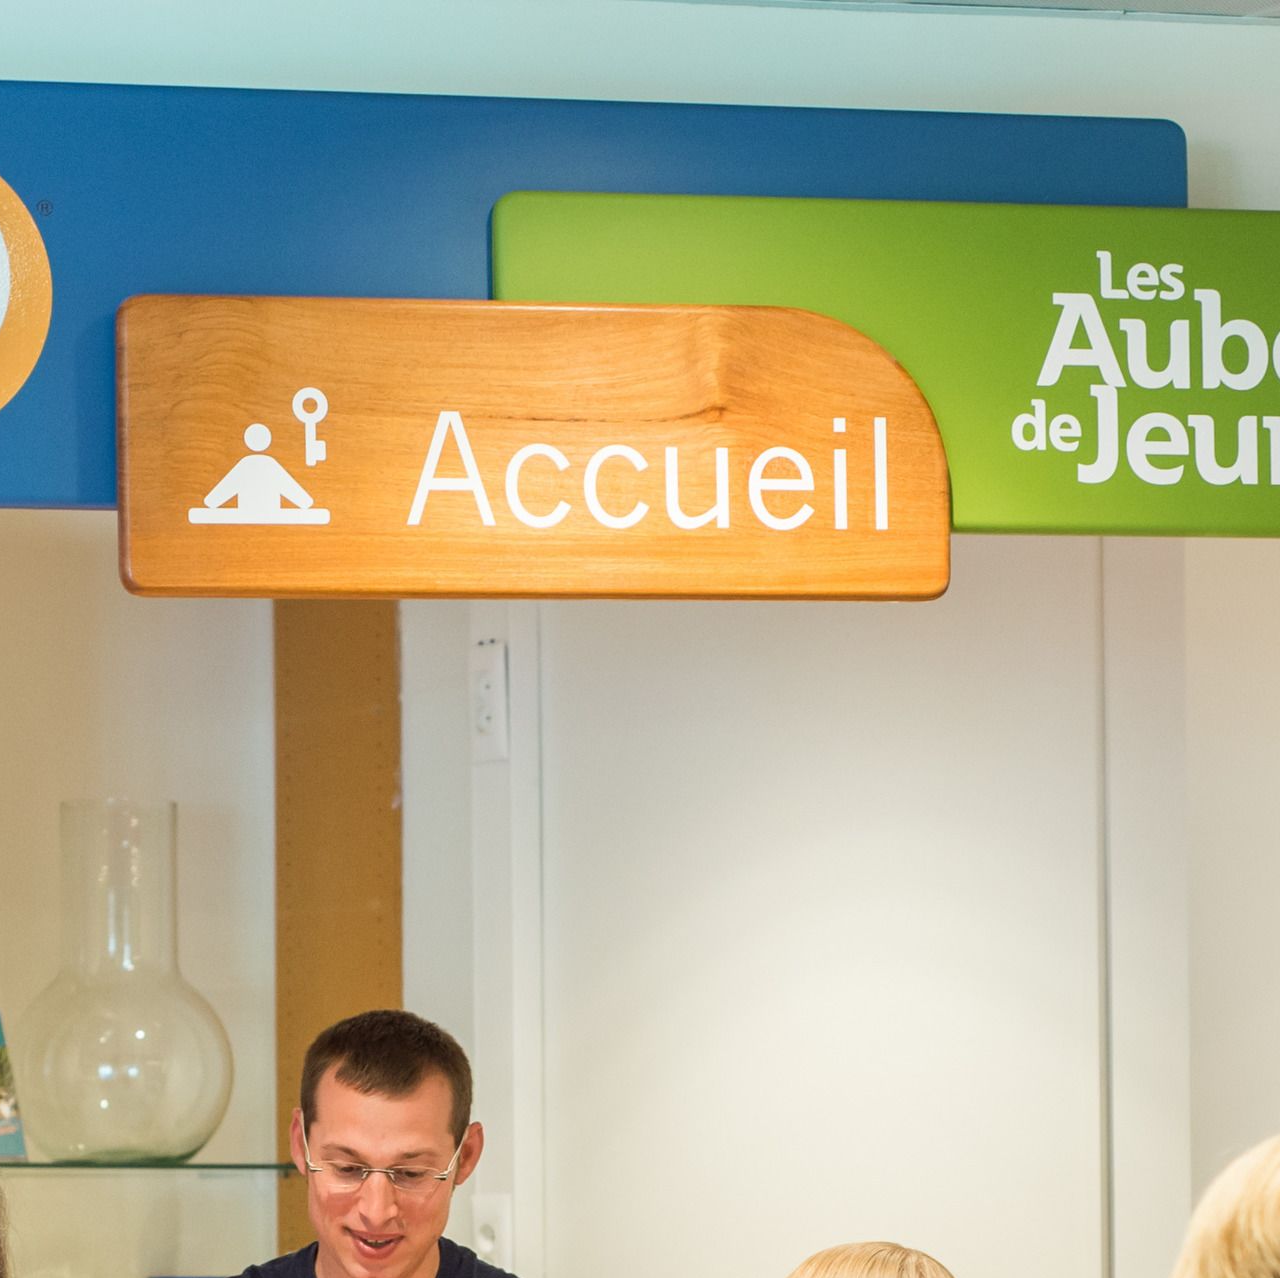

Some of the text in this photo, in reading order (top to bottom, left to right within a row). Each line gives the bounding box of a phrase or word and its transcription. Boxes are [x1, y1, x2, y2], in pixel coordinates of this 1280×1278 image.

[1096, 250, 1185, 300] Les
[1011, 398, 1082, 452] de
[405, 410, 889, 531] Accueil
